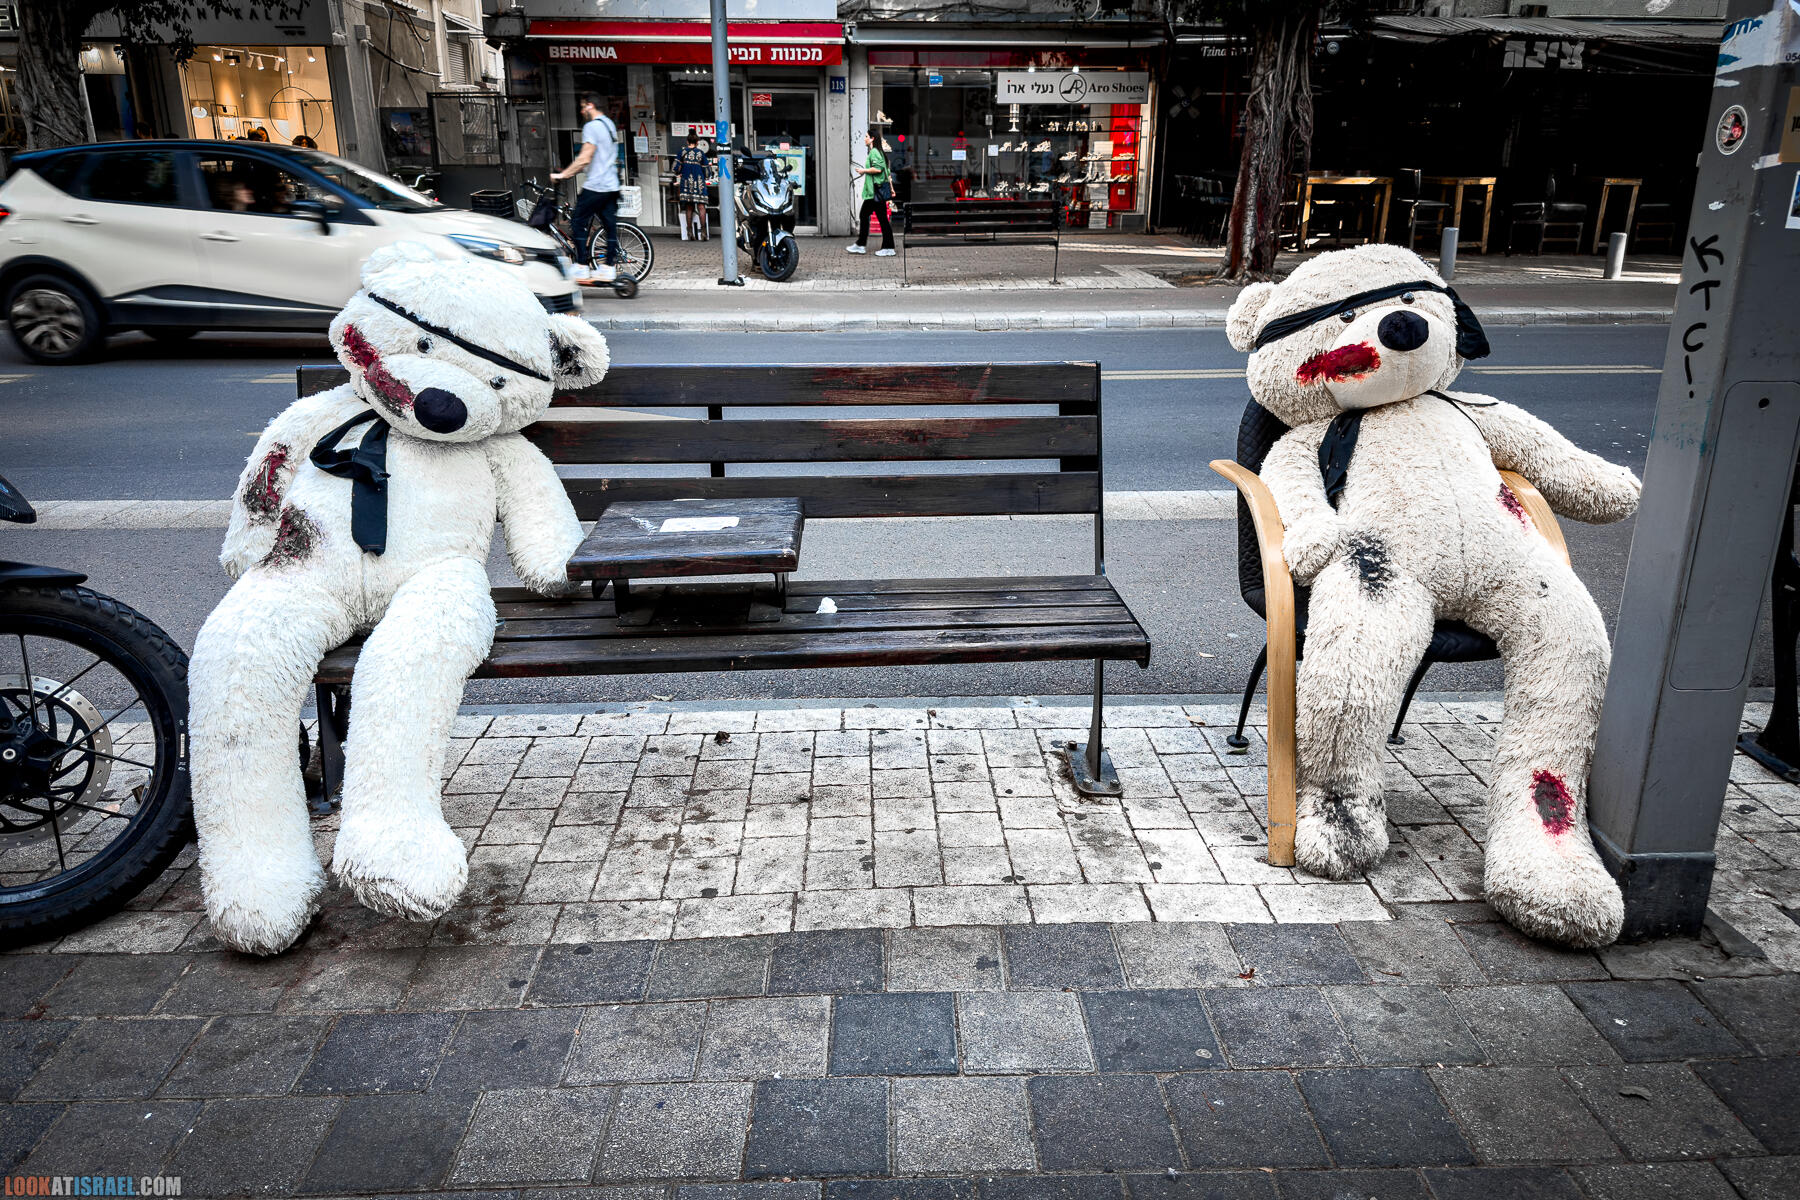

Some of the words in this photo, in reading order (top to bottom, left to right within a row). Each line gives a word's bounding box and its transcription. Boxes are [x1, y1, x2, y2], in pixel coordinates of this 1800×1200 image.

[549, 46, 617, 59] BERNINA
[771, 48, 822, 61] מכונות
[1031, 82, 1054, 93] נעלי
[1088, 82, 1110, 93] Aro
[1112, 82, 1145, 93] Shoes
